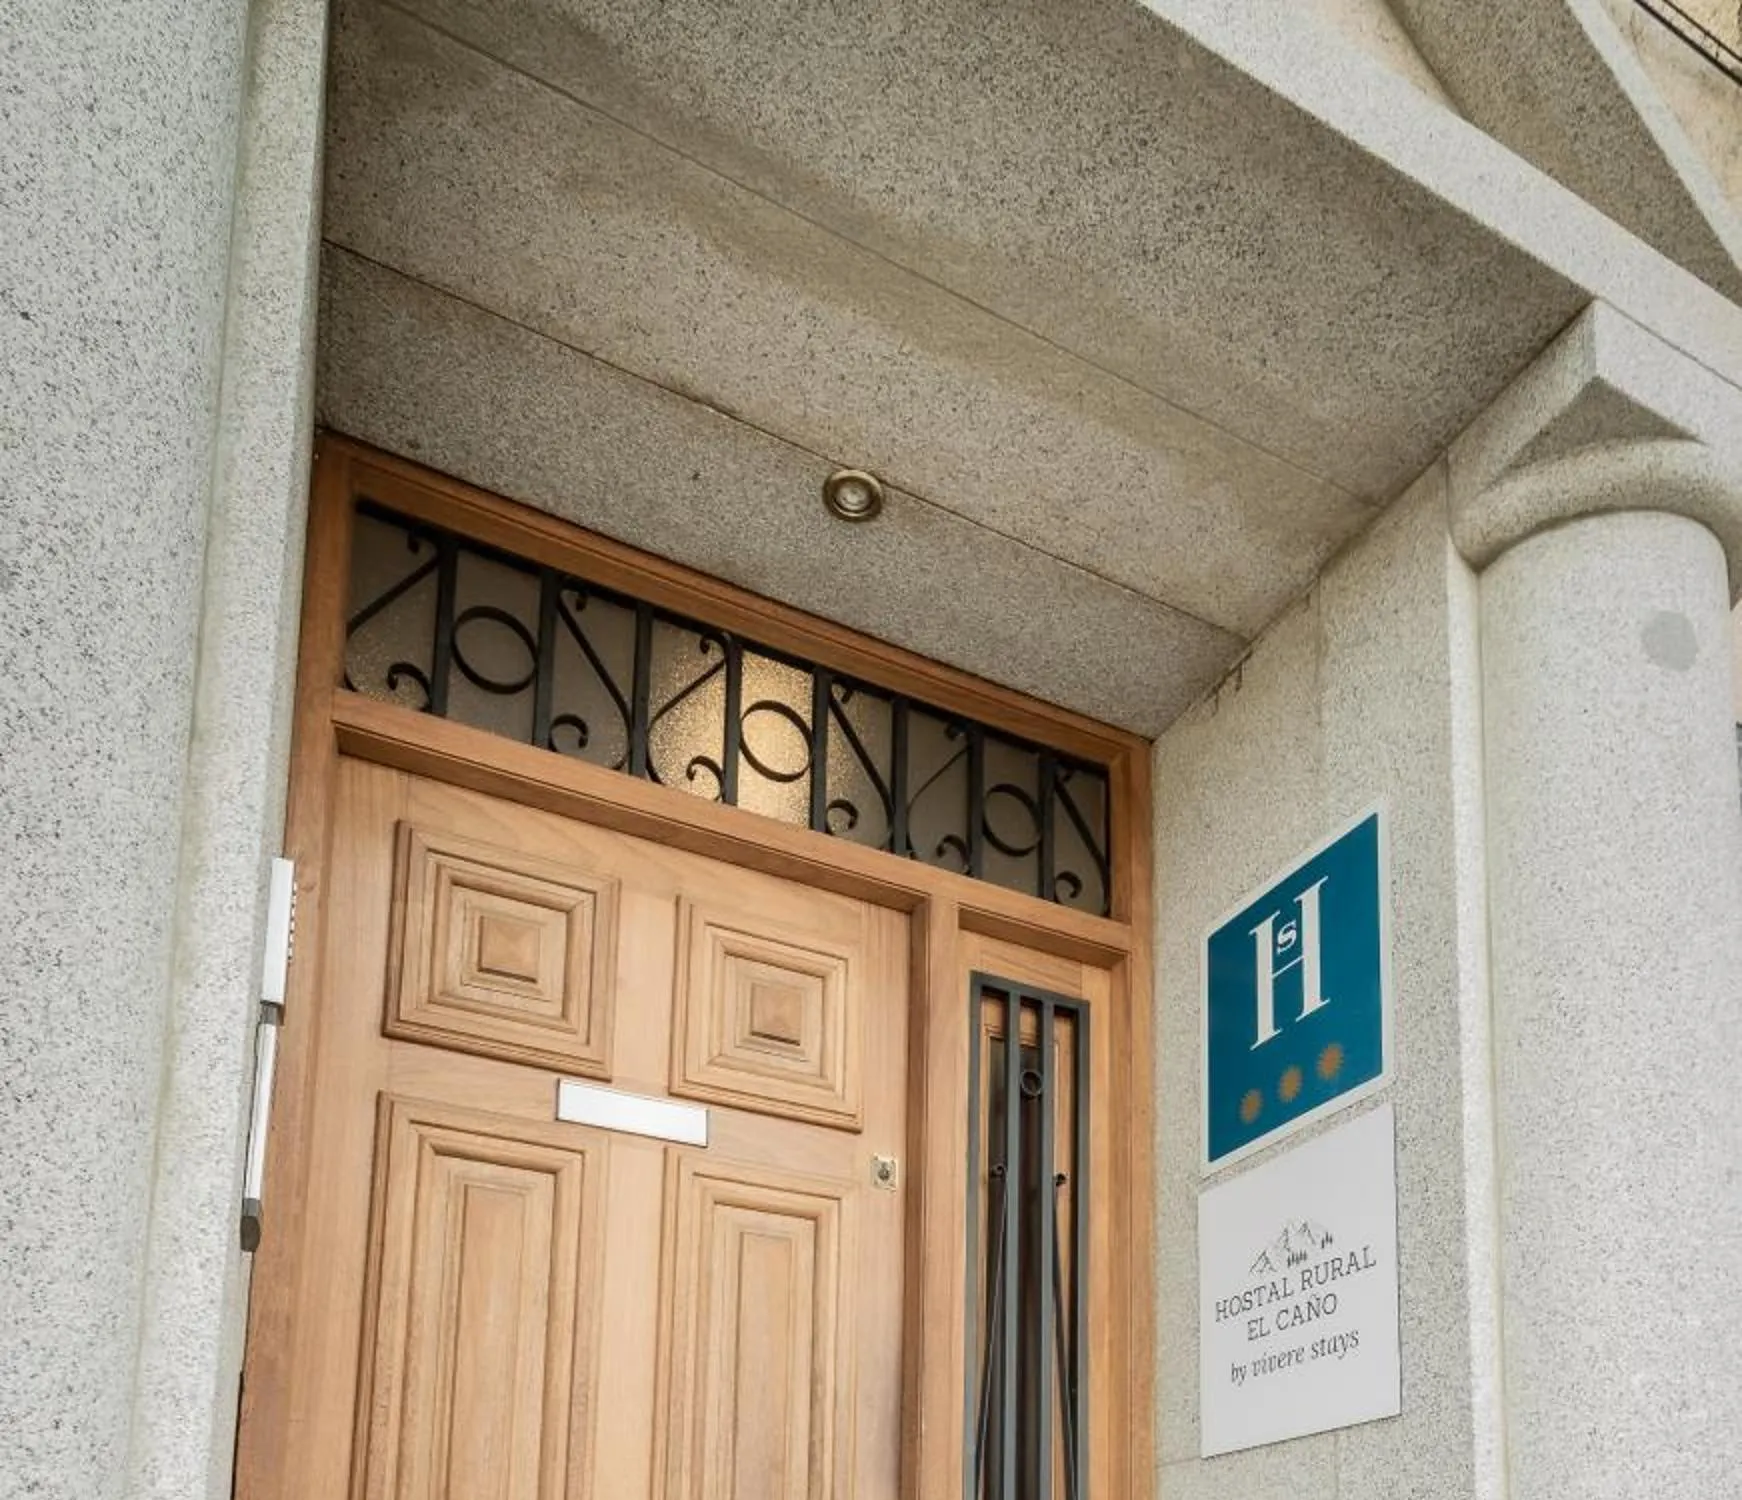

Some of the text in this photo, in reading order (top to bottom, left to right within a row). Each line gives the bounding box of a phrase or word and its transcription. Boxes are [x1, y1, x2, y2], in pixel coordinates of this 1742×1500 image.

[1215, 1245, 1377, 1322] HOSTAL RURAL
[1247, 1316, 1271, 1341] EL
[1231, 1329, 1360, 1386] by vivere stays
